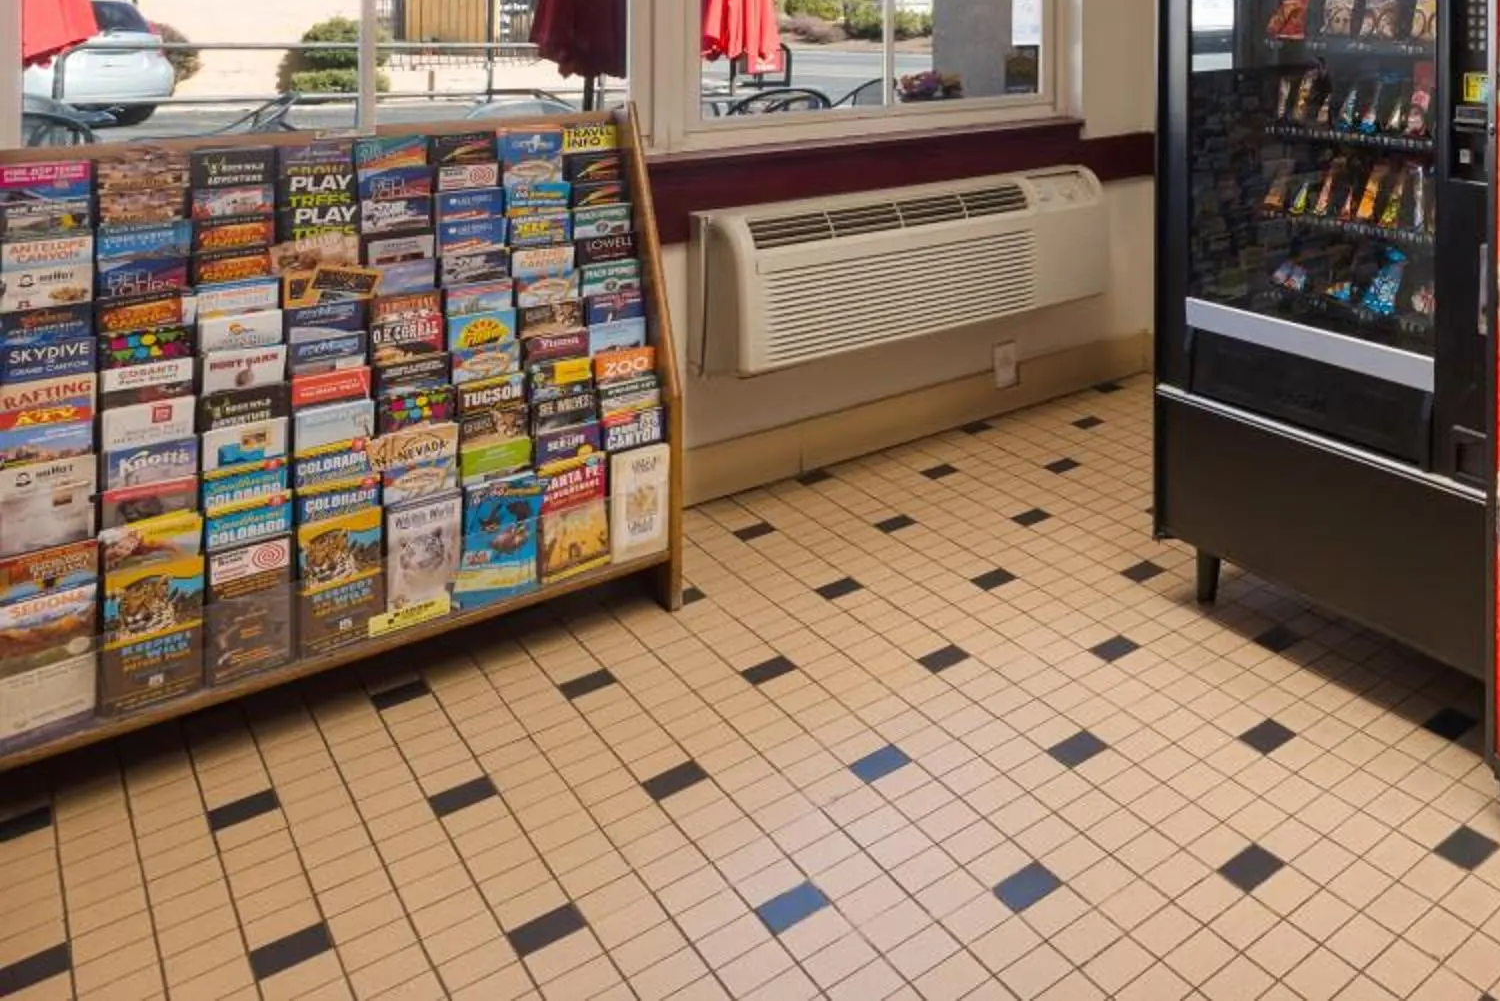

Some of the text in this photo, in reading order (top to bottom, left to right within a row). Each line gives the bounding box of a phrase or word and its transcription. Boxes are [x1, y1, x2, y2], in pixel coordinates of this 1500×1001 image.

[290, 174, 352, 192] PLAY
[295, 206, 357, 224] PLAY
[9, 342, 90, 364] SKYDIVE
[605, 356, 649, 377] ZOO
[4, 380, 92, 410] RAFTING
[463, 383, 523, 408] TUCSON
[400, 440, 447, 460] NEVADA
[607, 427, 662, 450] CANYON
[297, 451, 367, 476] COLORADO
[205, 482, 281, 509] COLORADO
[305, 487, 377, 513] COLORADO
[209, 518, 285, 547] COLORADO
